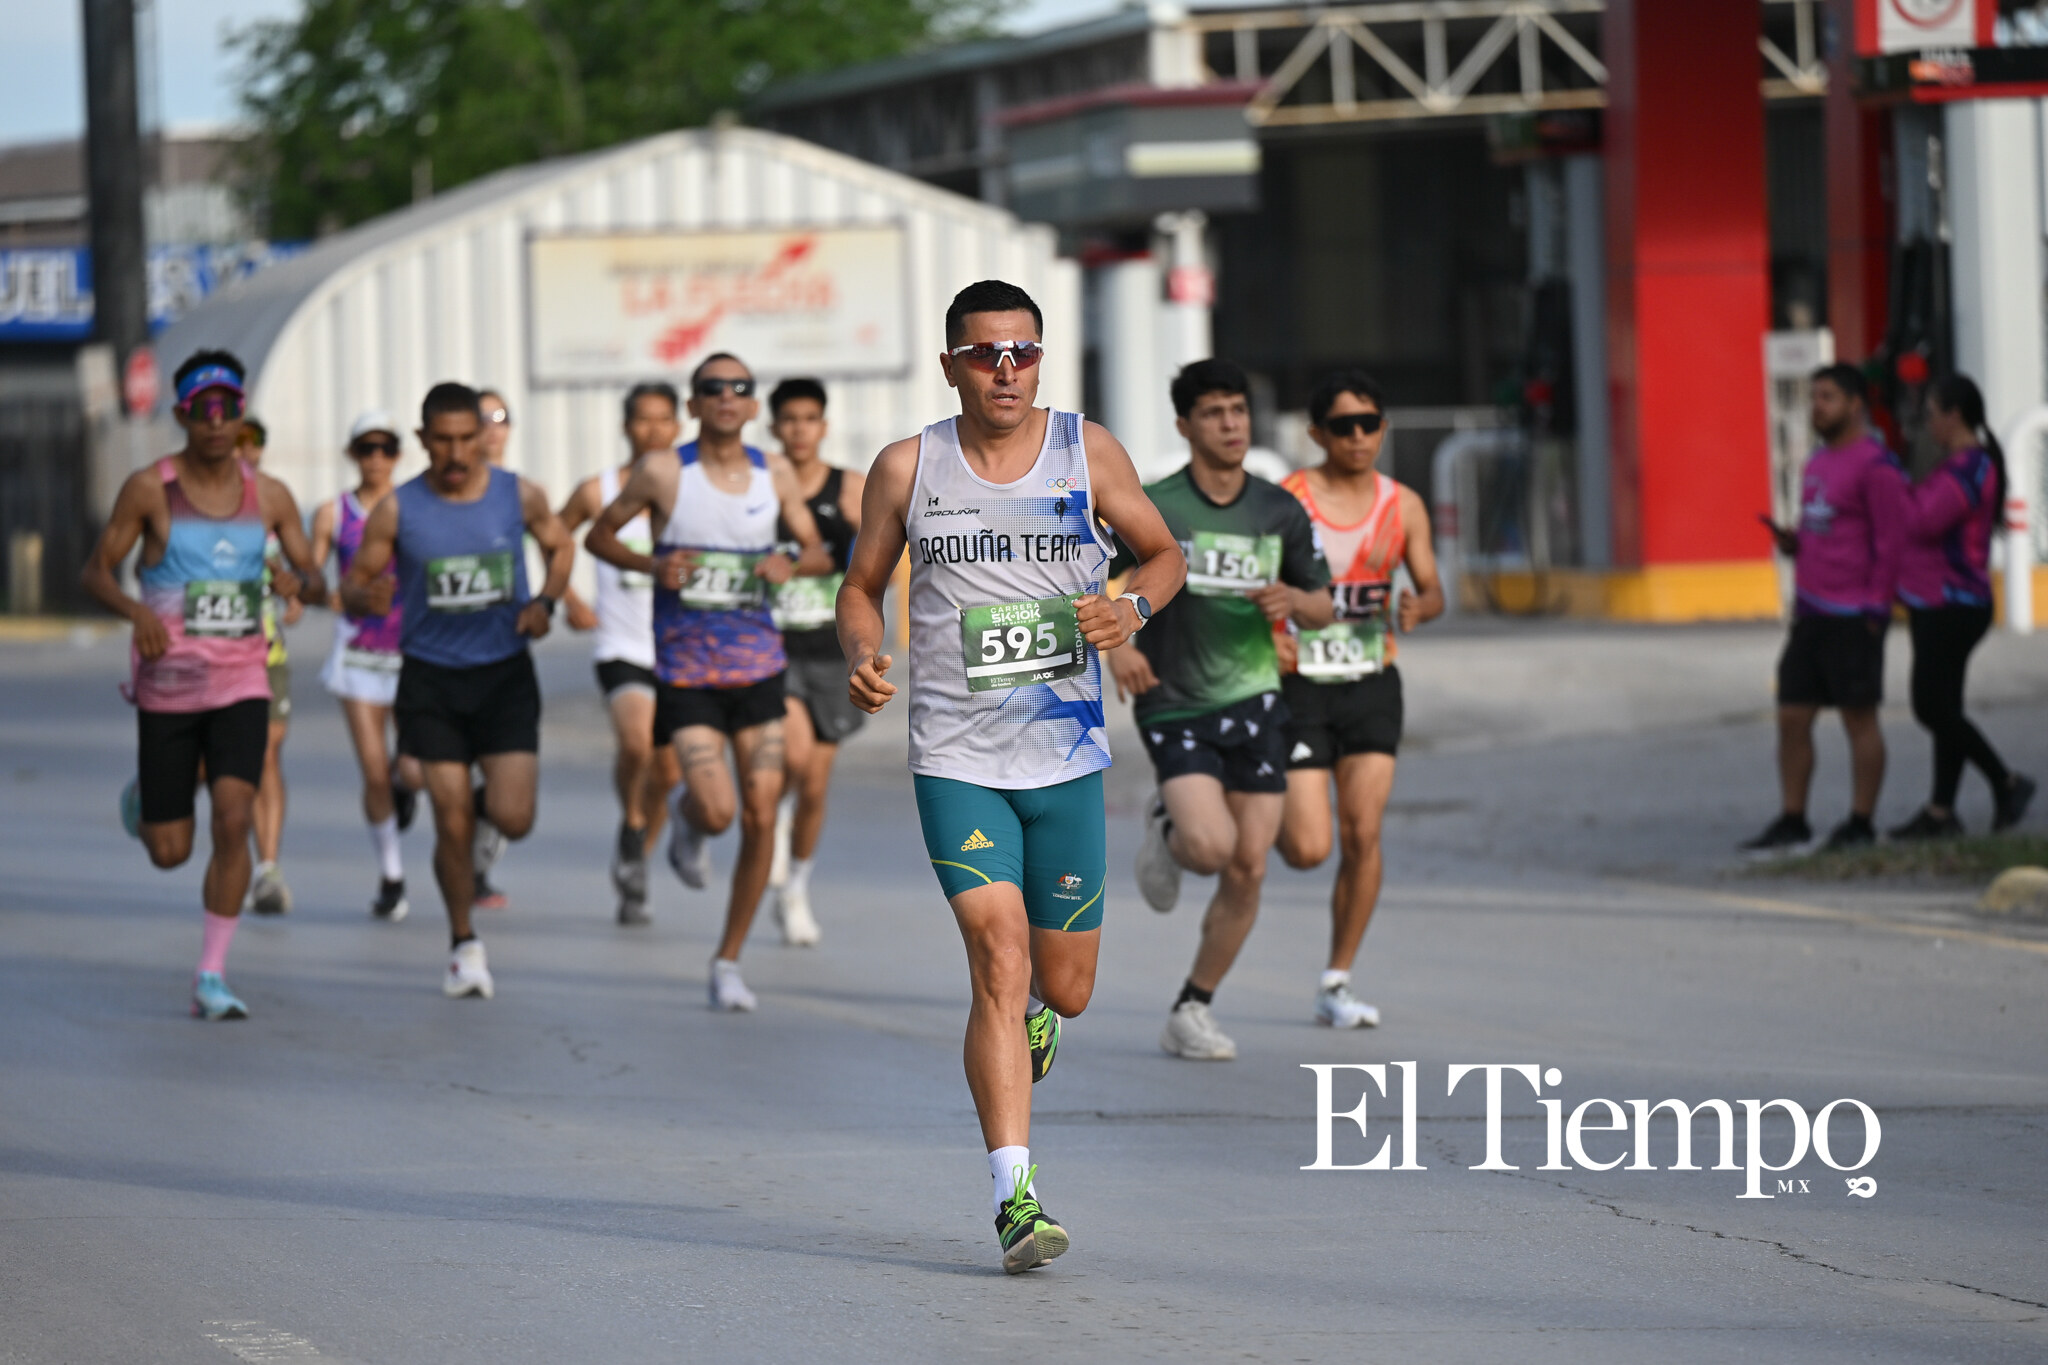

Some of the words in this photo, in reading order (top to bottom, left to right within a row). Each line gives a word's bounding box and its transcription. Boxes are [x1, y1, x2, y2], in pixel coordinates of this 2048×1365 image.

[924, 508, 981, 518] ORDUÑA
[919, 529, 1012, 564] ORDUÑA
[1020, 534, 1081, 562] TEAM
[1204, 550, 1260, 580] 150
[437, 569, 491, 597] 174
[990, 602, 1040, 614] CARRERA
[982, 622, 1058, 663] 595
[1310, 637, 1364, 664] 190
[961, 840, 995, 852] adidas
